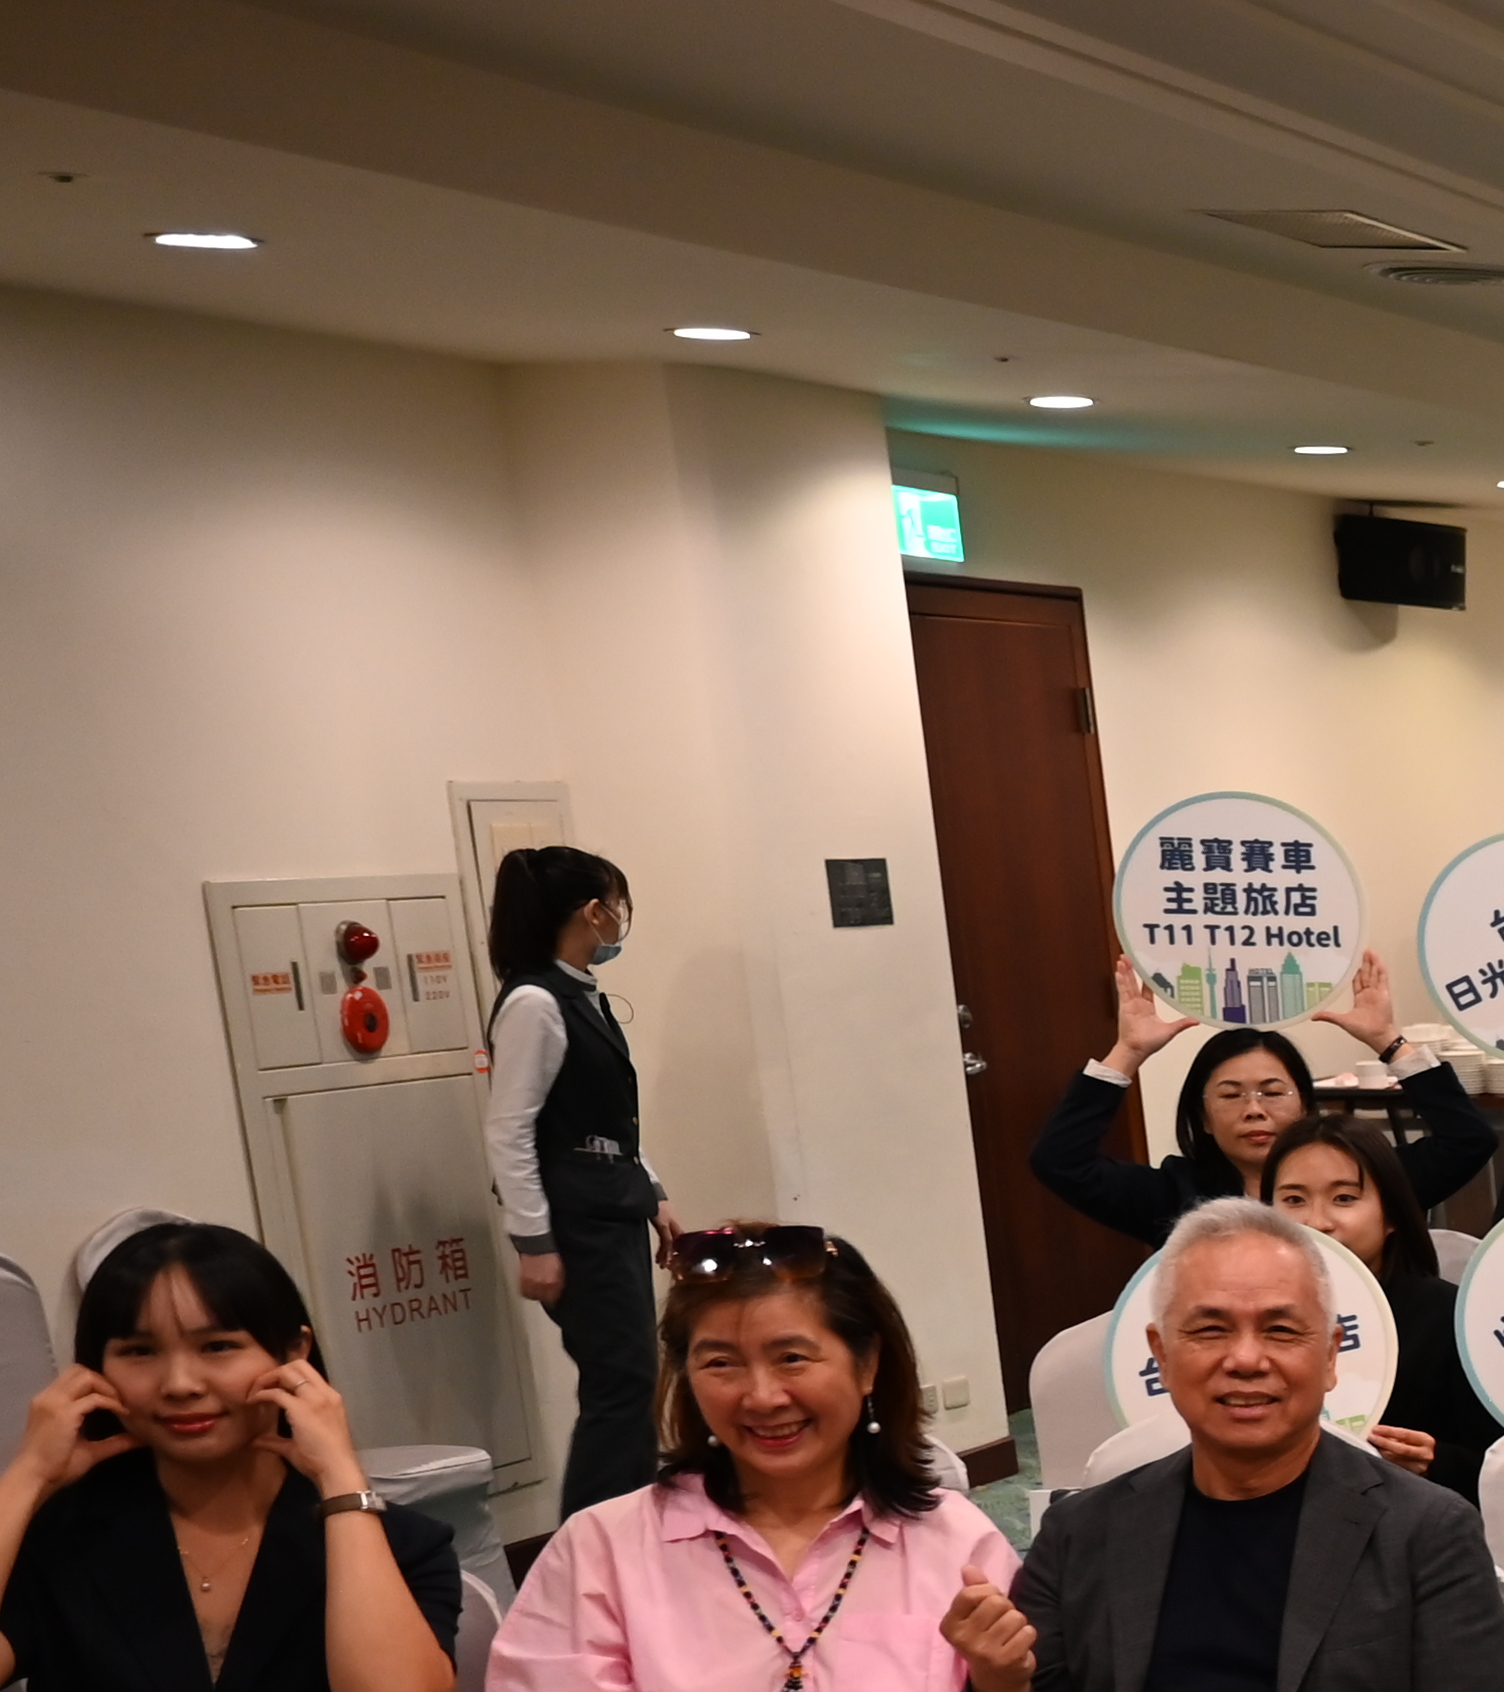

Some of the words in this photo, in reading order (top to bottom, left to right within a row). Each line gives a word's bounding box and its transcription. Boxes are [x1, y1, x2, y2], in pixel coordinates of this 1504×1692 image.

[1158, 837, 1316, 874] 麗寶賽車
[1163, 881, 1317, 916] 主題旅店
[1142, 923, 1194, 945] T11
[1203, 925, 1257, 946] T12
[1265, 925, 1341, 948] Hotel
[346, 1237, 469, 1301] 消防箱
[355, 1288, 472, 1332] HYDRANT
